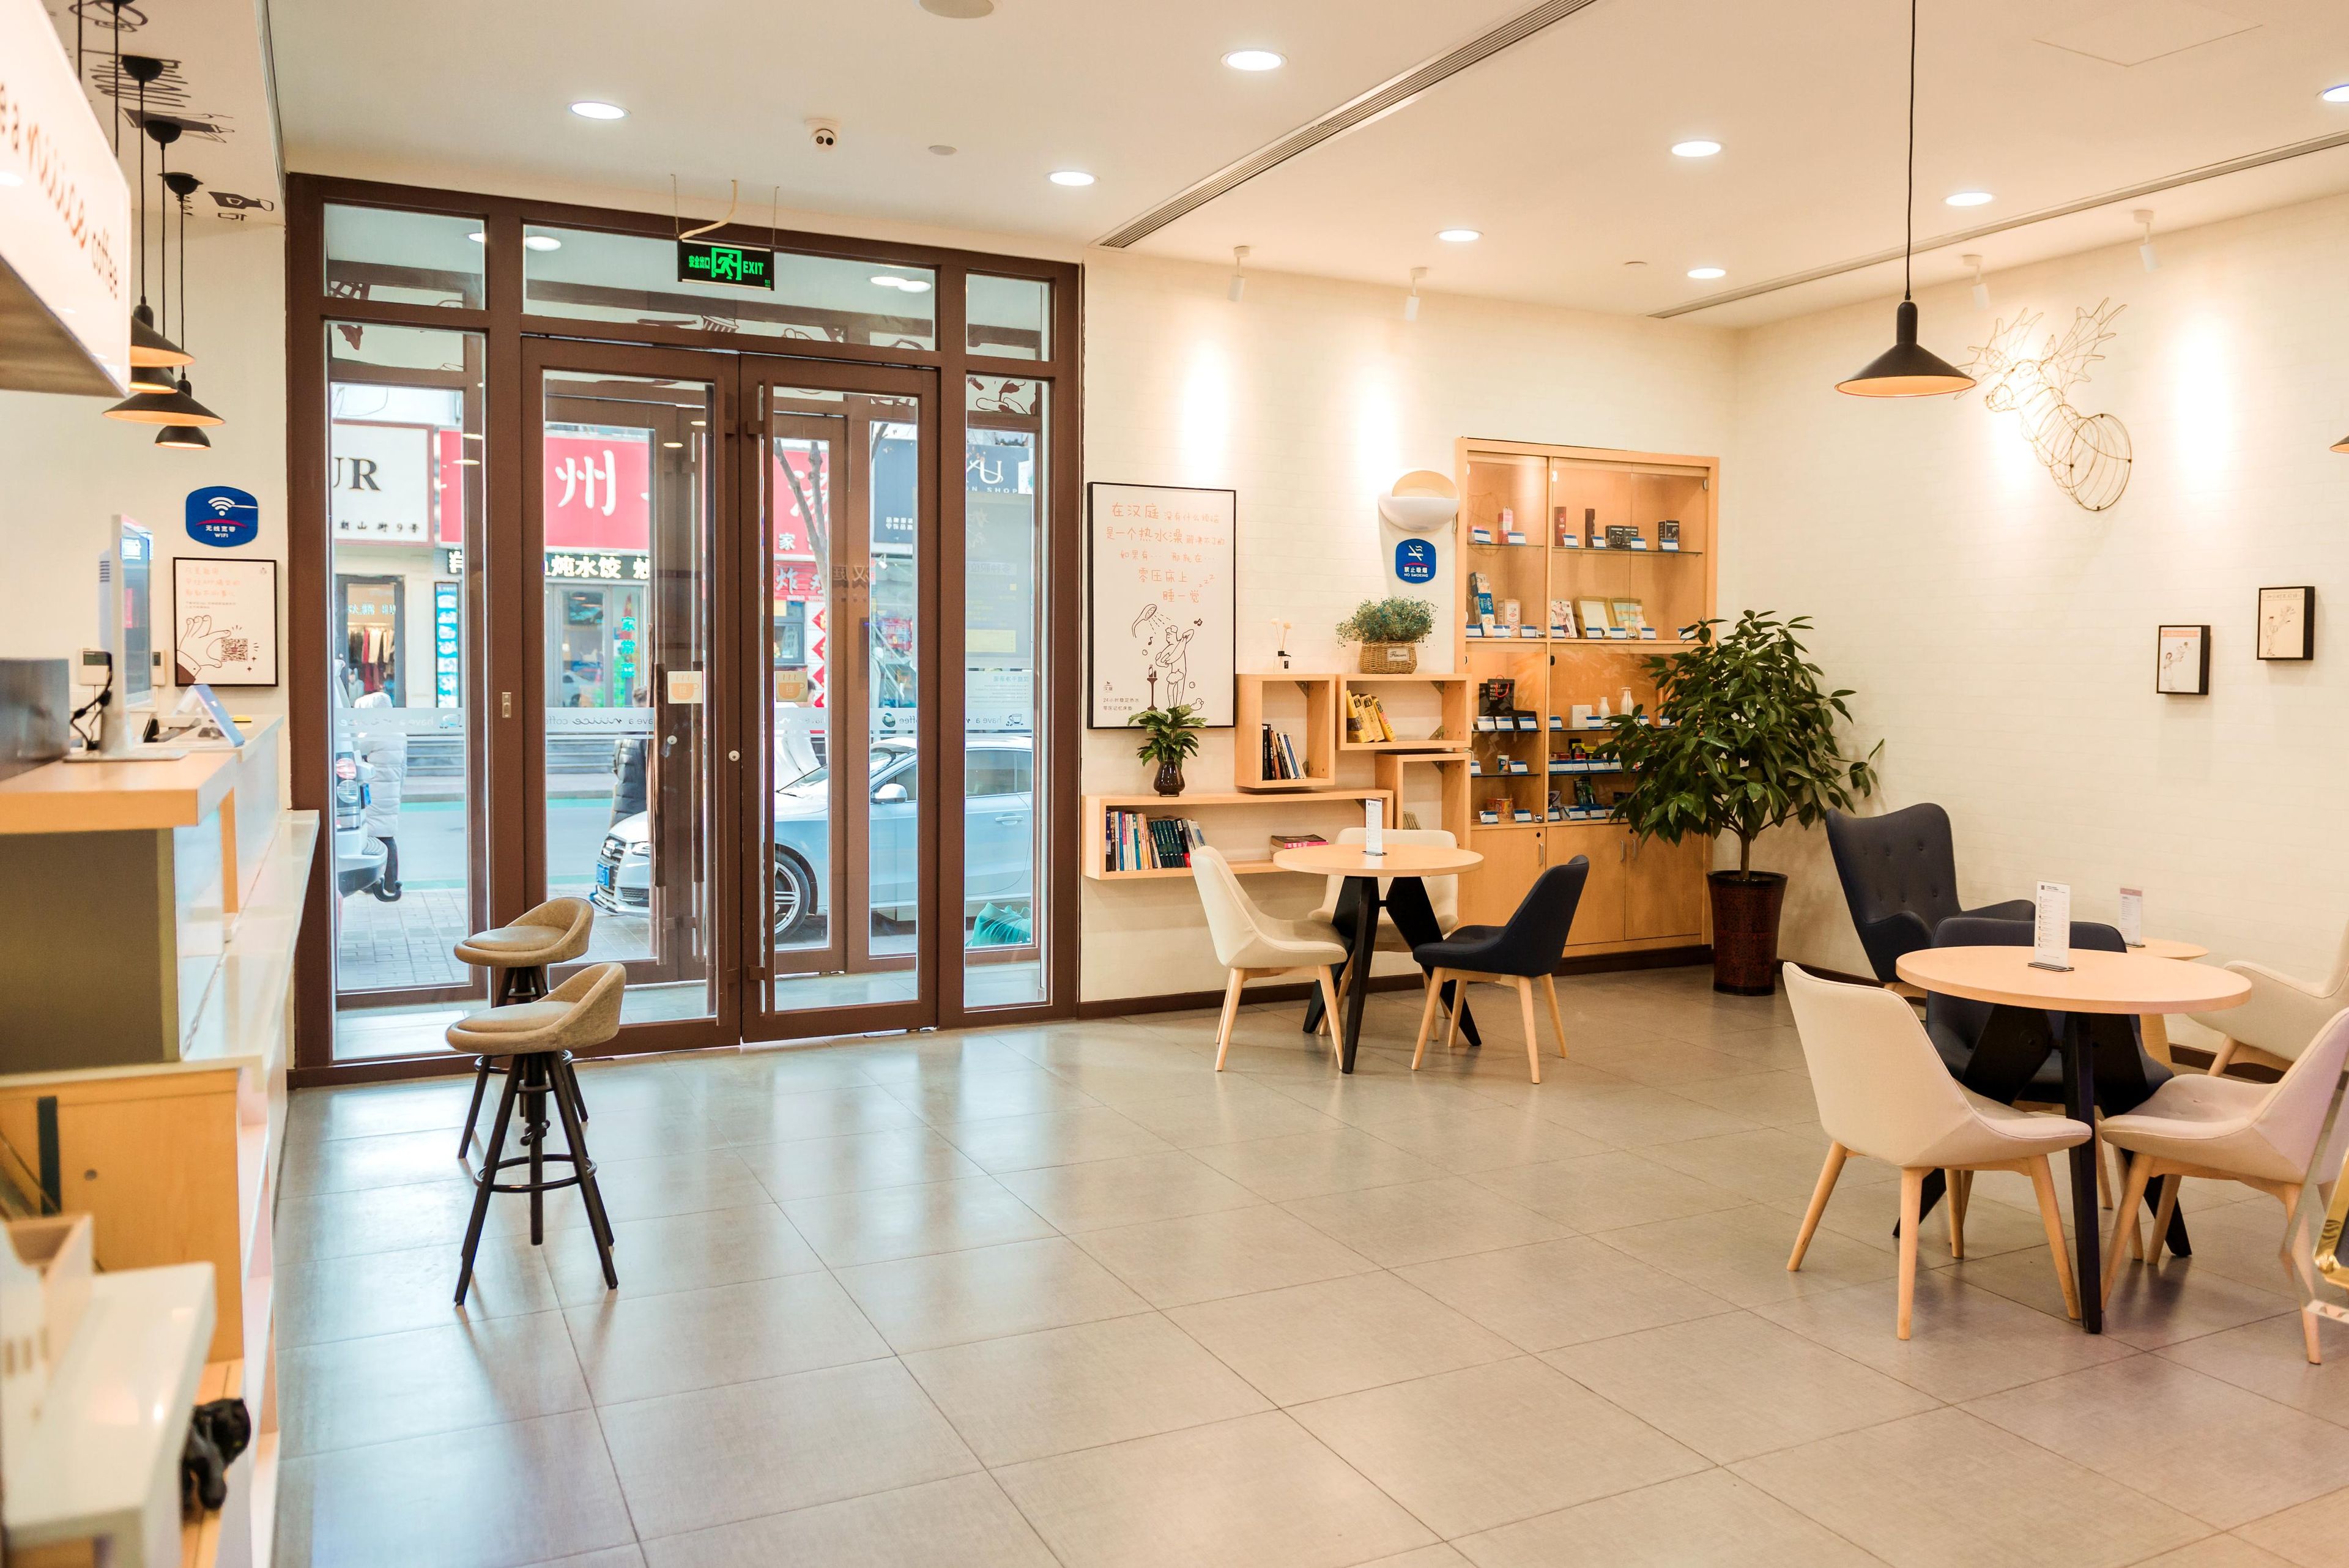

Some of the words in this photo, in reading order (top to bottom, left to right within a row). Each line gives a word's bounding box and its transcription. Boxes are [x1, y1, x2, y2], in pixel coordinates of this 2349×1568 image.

[91, 226, 118, 300] coffee
[688, 255, 710, 269] 安全出口
[743, 261, 764, 275] EXIT
[555, 450, 615, 516] 州
[1111, 502, 1160, 519] 在汉庭
[1106, 526, 1183, 543] 是一个热水澡
[1138, 567, 1187, 582] 零压床上
[1163, 588, 1200, 603] 睡一觉
